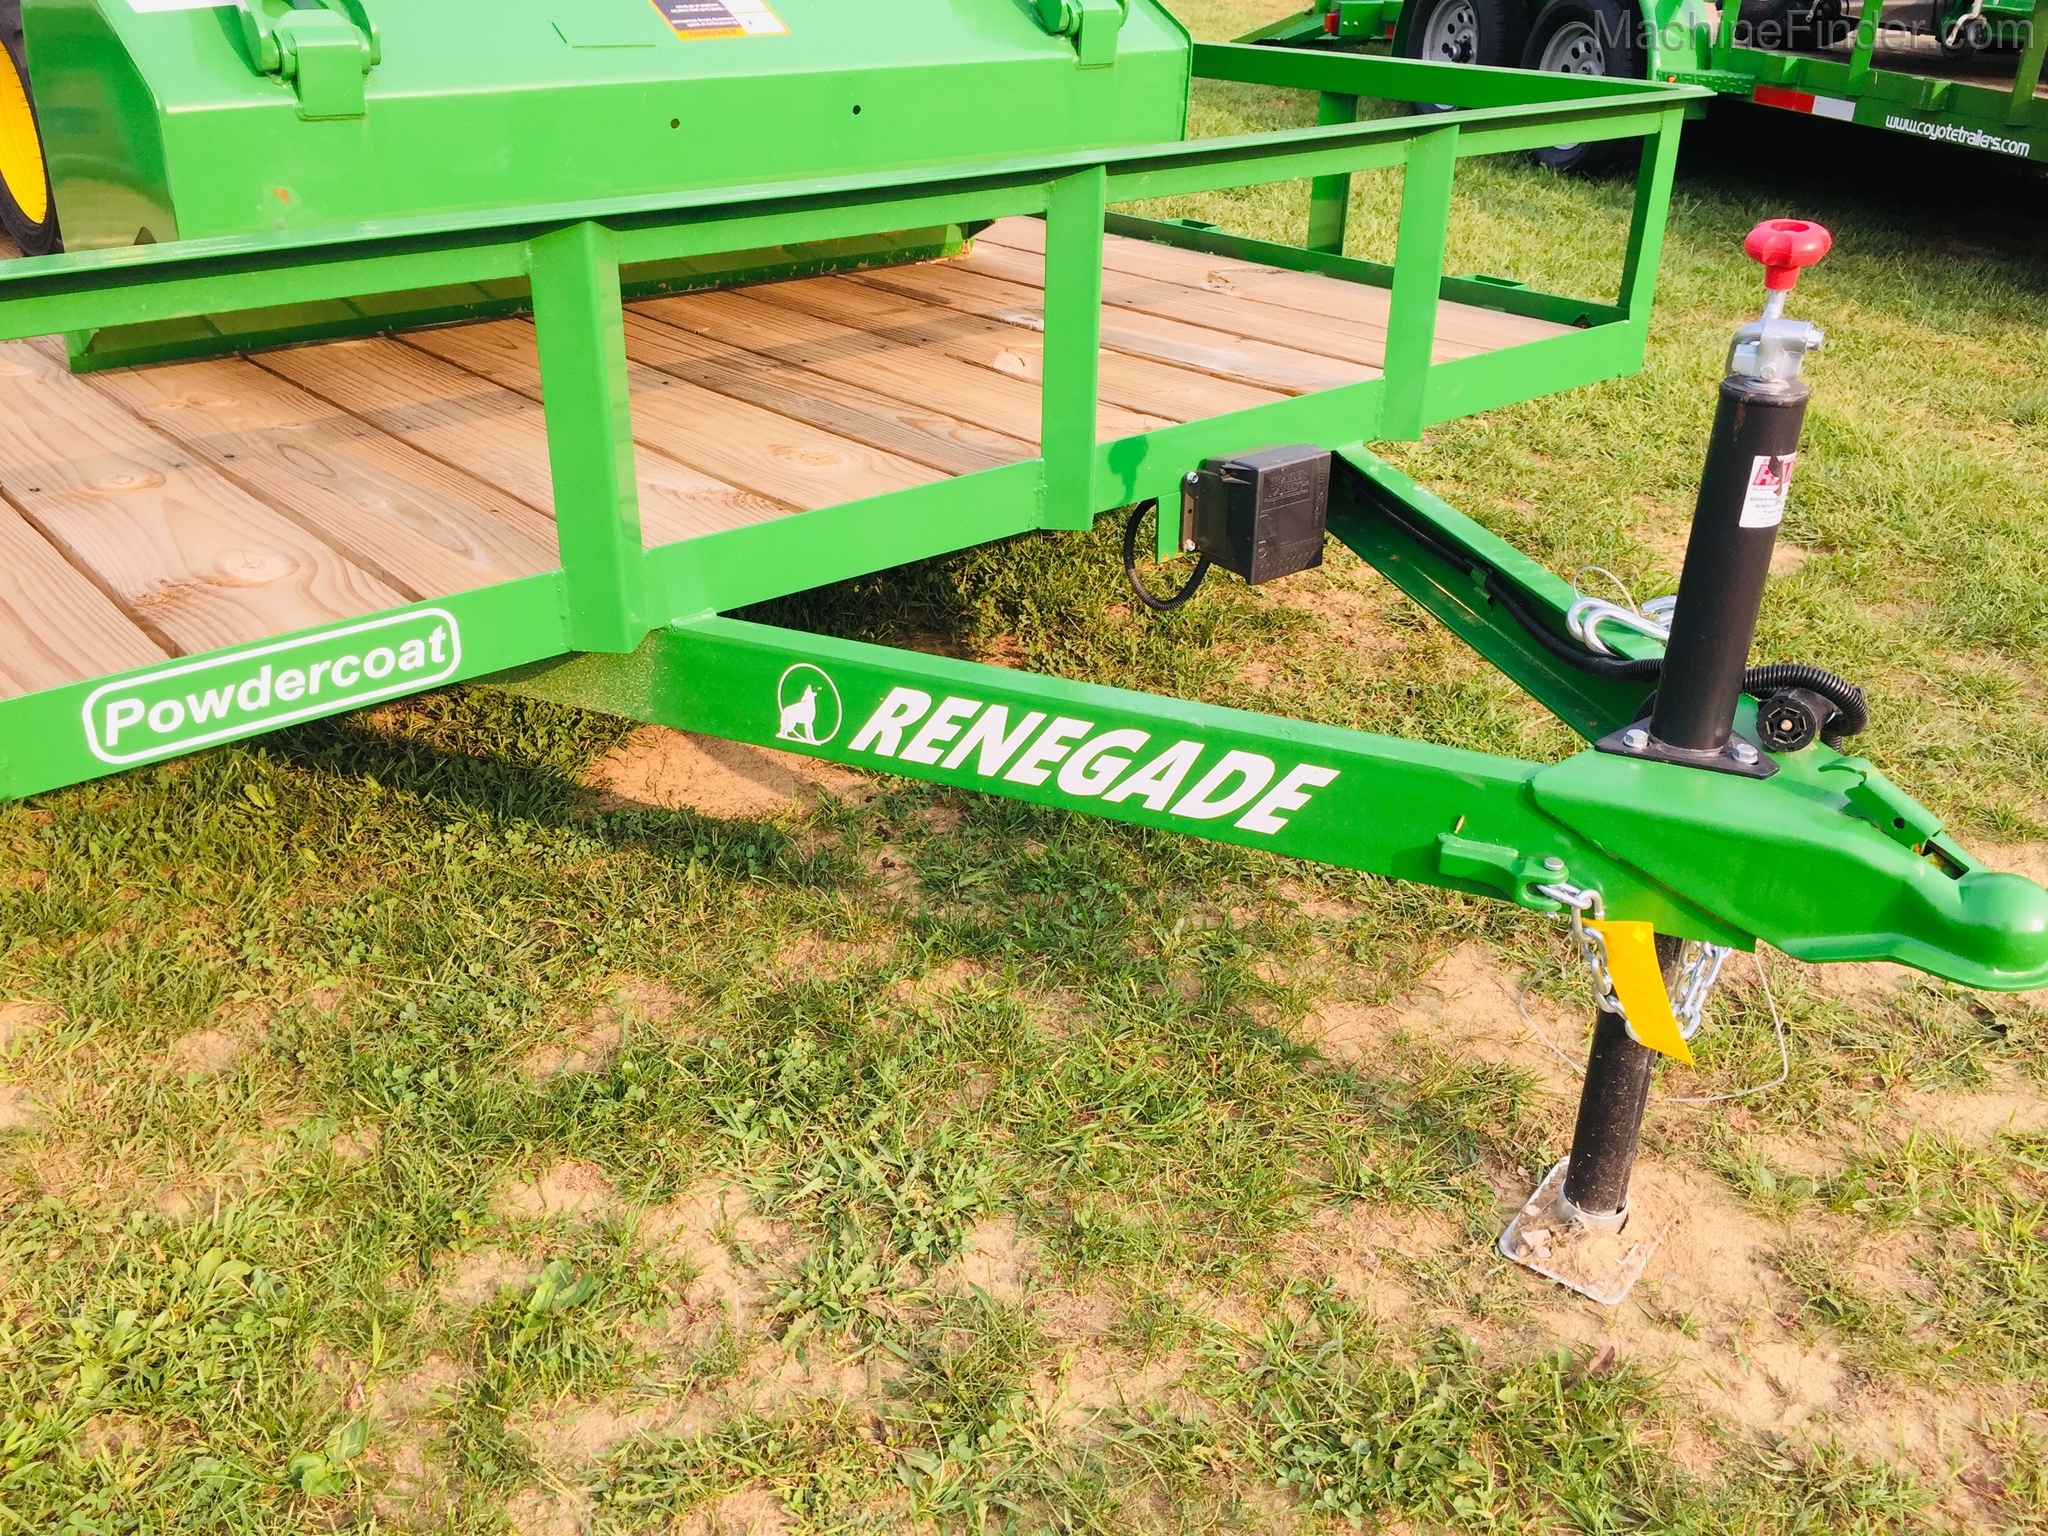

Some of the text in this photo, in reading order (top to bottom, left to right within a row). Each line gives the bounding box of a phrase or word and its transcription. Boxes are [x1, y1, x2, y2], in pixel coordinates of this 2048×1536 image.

[1885, 114, 2031, 158] www.coyotetrailers.com
[105, 624, 447, 747] Powdercoat
[847, 686, 1341, 835] RENEGADE
